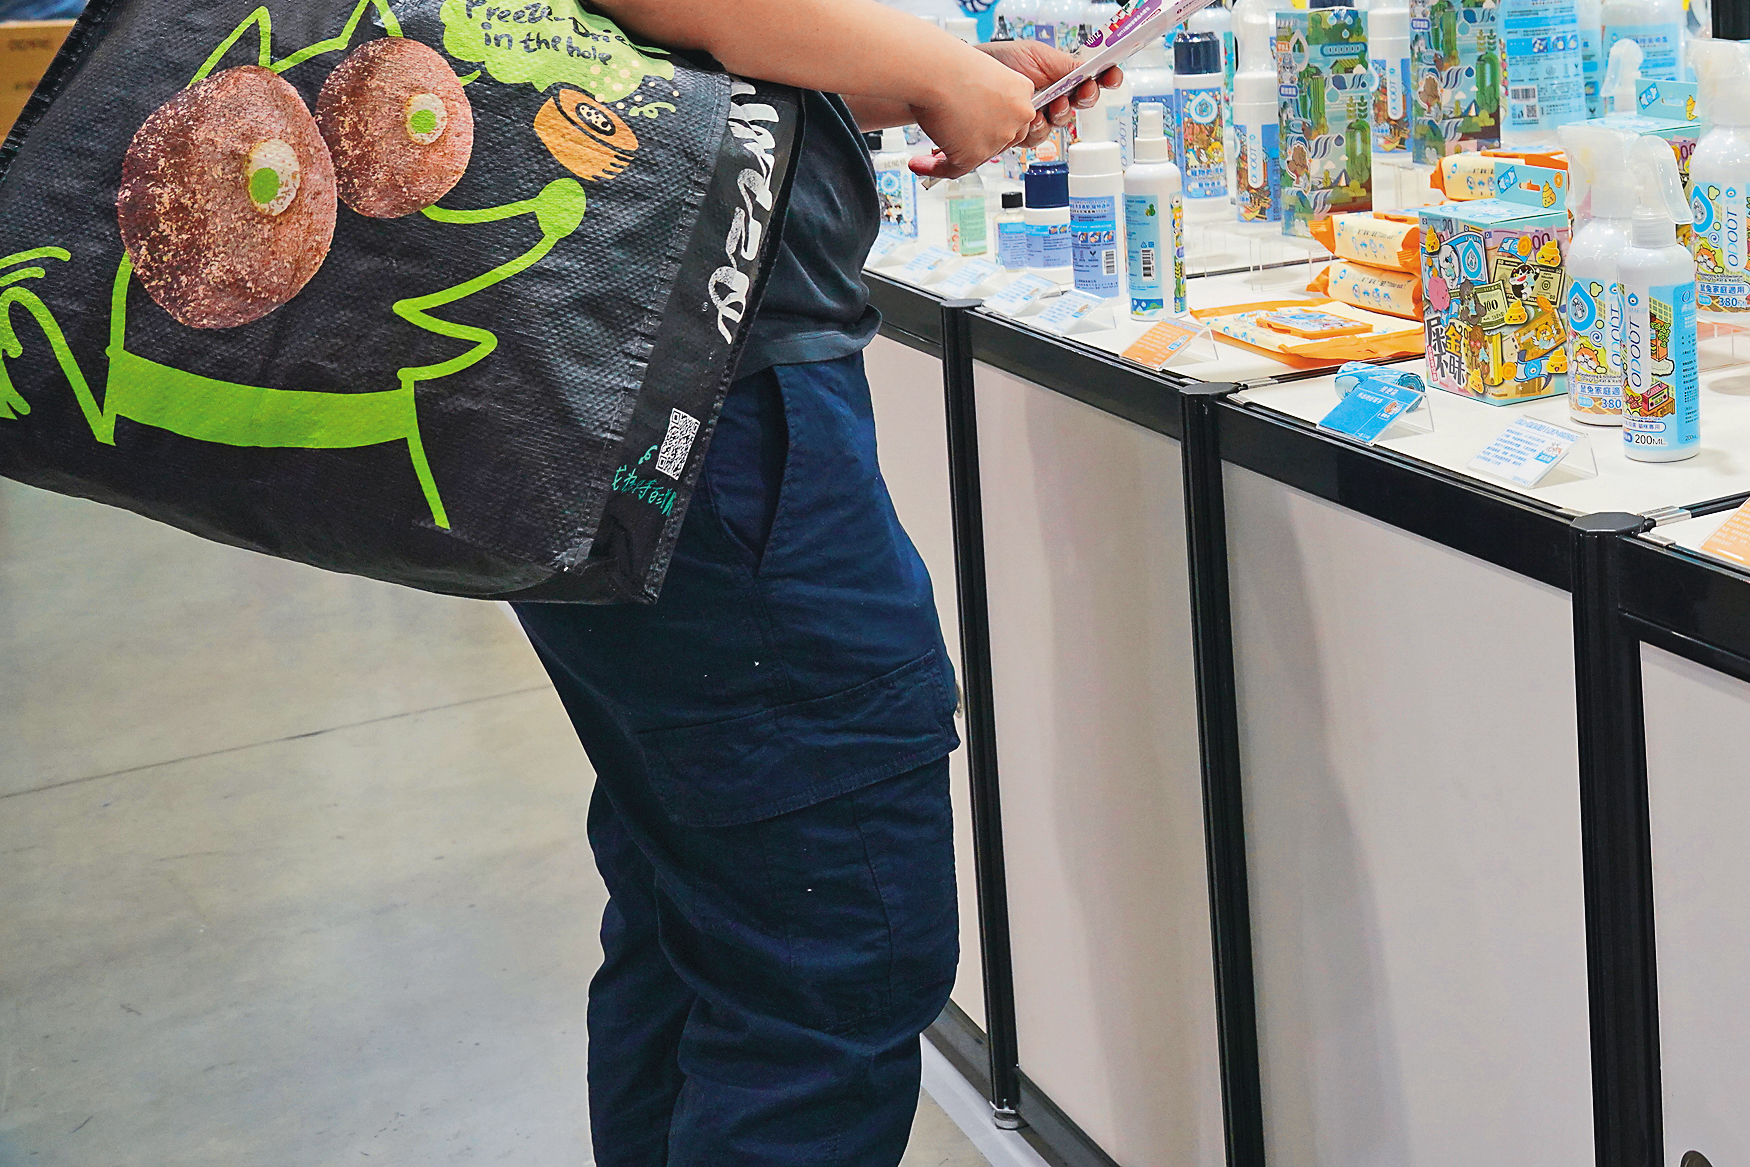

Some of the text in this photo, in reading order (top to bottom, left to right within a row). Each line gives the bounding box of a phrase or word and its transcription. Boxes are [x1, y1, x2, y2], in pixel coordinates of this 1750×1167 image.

[481, 22, 613, 66] in the hole
[1726, 207, 1739, 268] ODOUT
[1630, 316, 1642, 388] ODOUT
[1580, 384, 1622, 396] 鼠兔家庭適
[1634, 434, 1667, 446] 200ML
